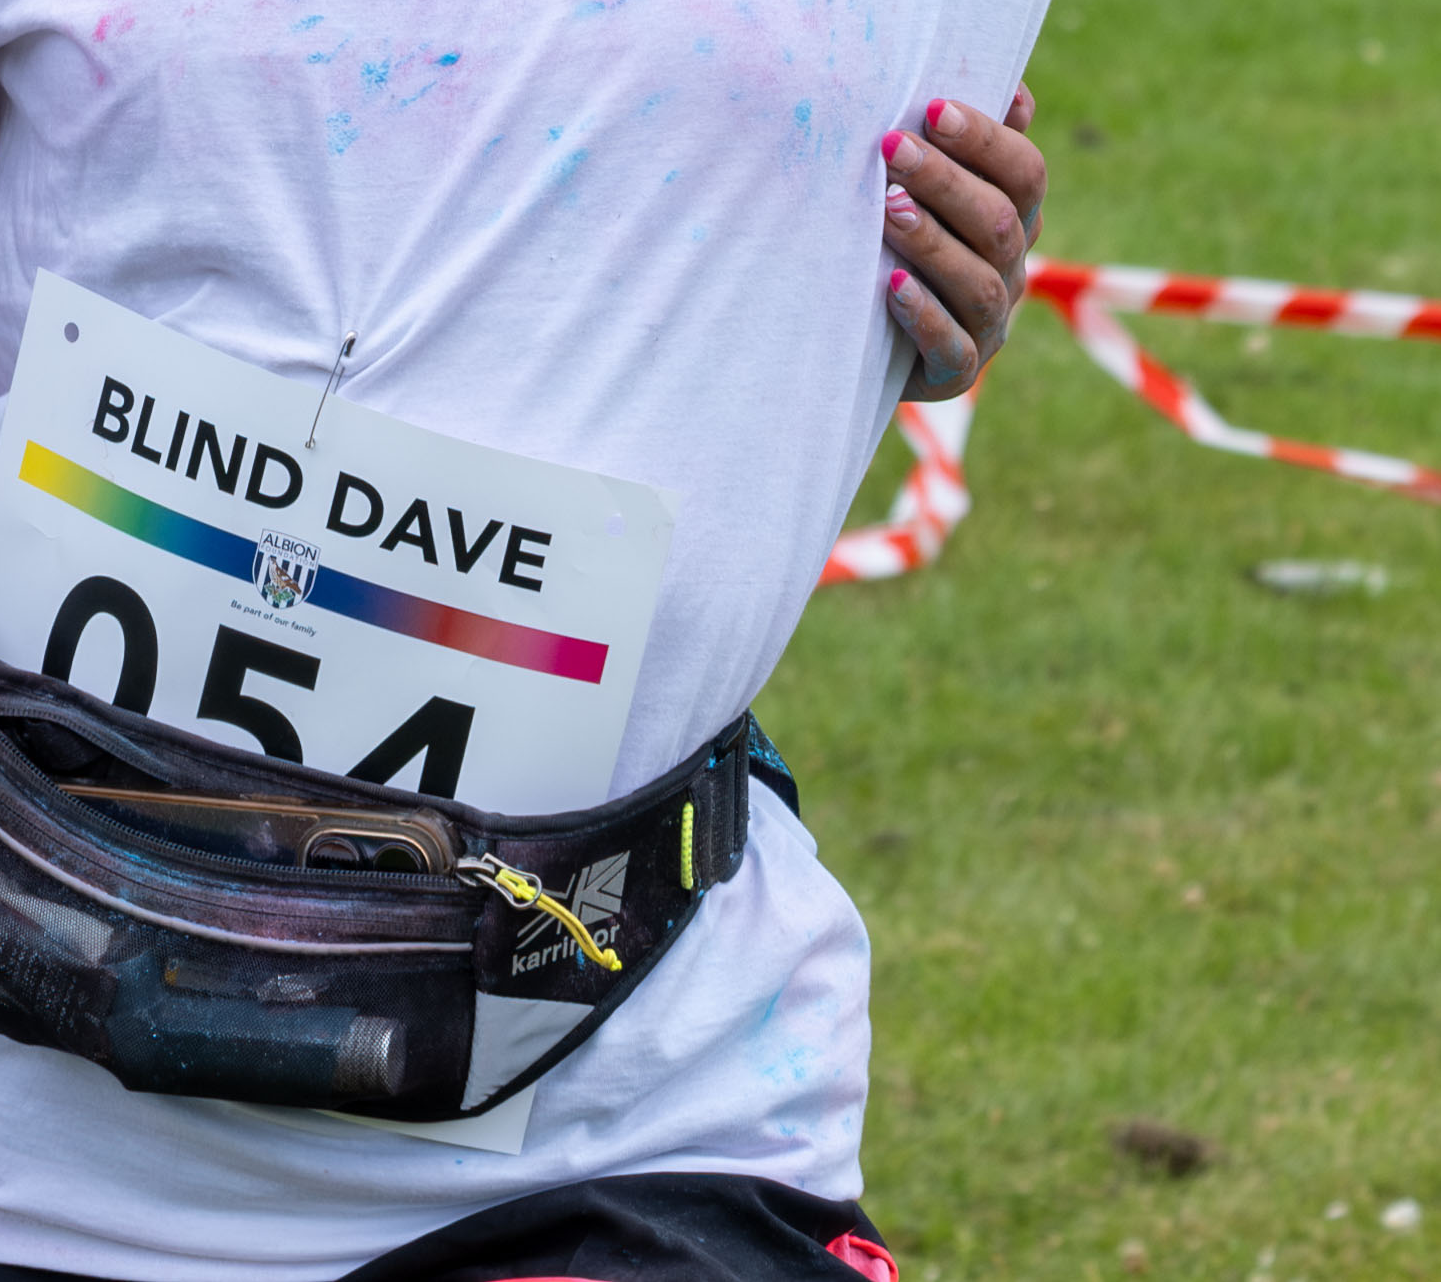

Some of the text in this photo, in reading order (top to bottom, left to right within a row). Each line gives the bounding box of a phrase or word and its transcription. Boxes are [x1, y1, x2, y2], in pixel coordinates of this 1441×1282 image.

[92, 374, 553, 593] BLIND DAVE
[263, 533, 317, 562] ALBION
[230, 599, 317, 638] Be part of our family
